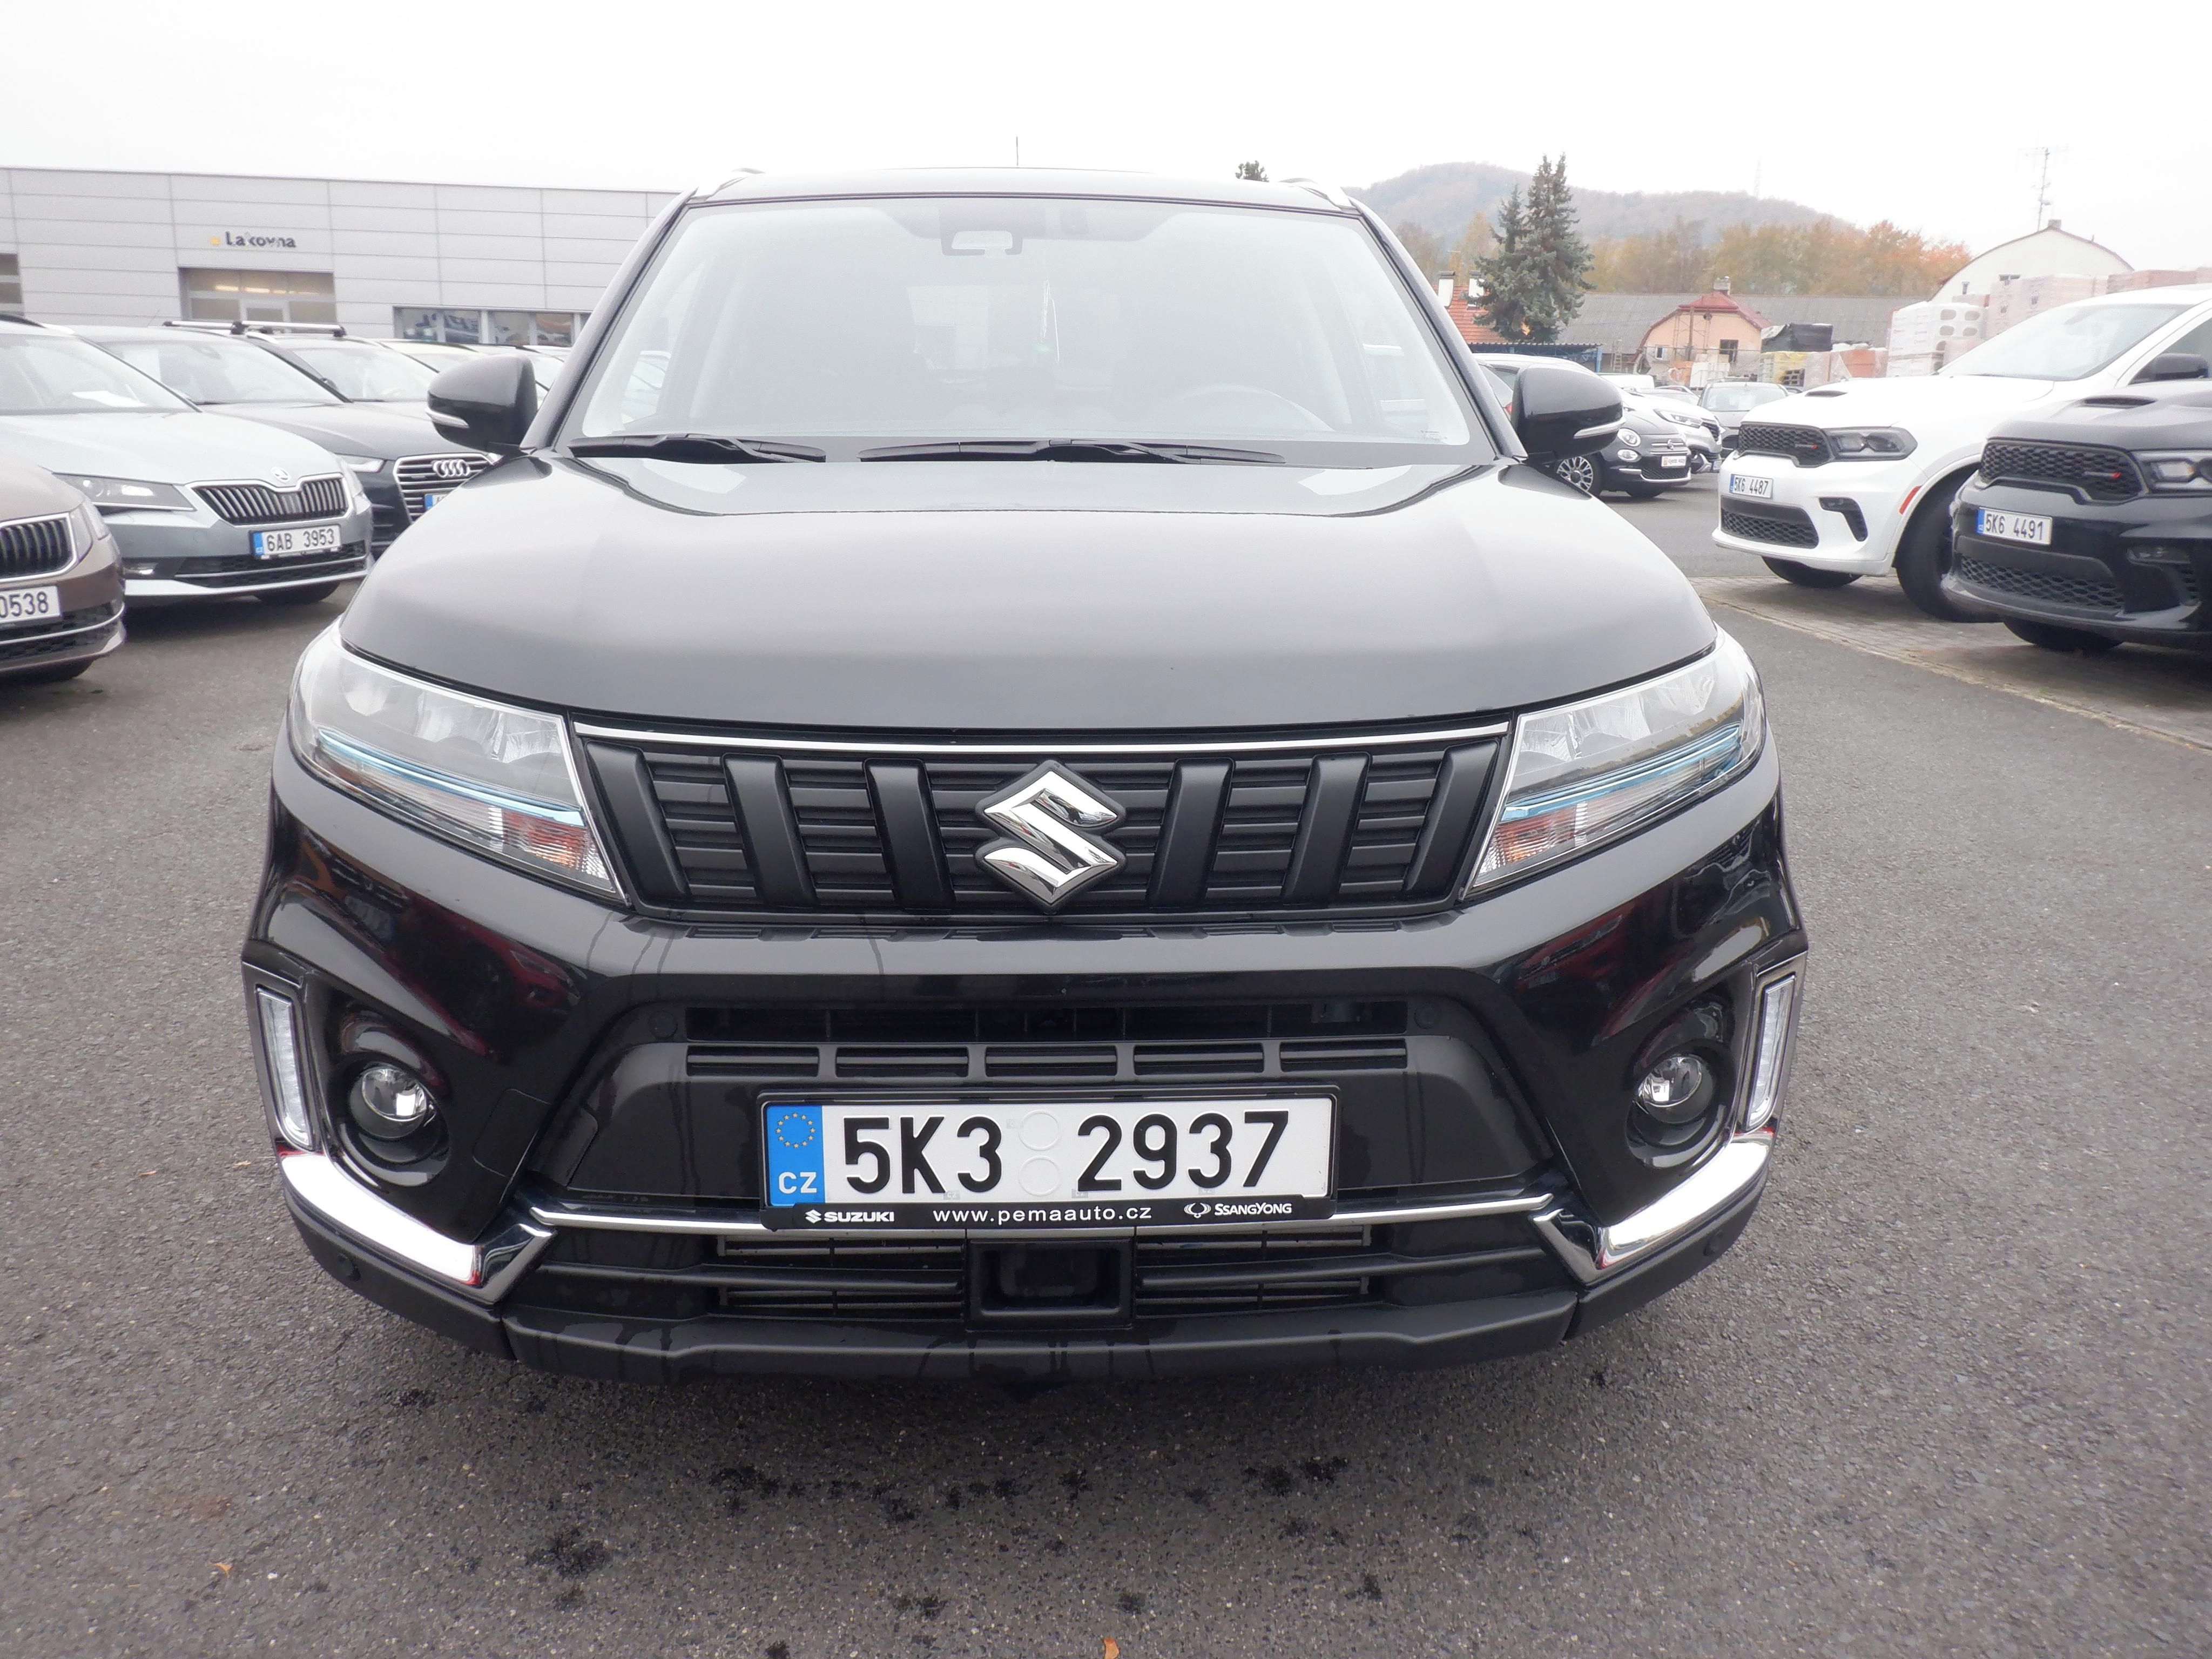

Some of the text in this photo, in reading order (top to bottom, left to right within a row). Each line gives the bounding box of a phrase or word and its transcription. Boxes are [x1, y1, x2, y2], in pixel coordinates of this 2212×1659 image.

[1734, 477, 1769, 495] 5K6 4487
[1985, 513, 2044, 541] 5K6 4491
[266, 528, 334, 551] 6AB 3953
[0, 591, 49, 618] 0538
[844, 1110, 1289, 1194] 5K3 2937
[778, 1171, 818, 1194] CZ
[824, 1211, 895, 1223] SUZUKI
[933, 1205, 1152, 1225] www.pemaauto.cz
